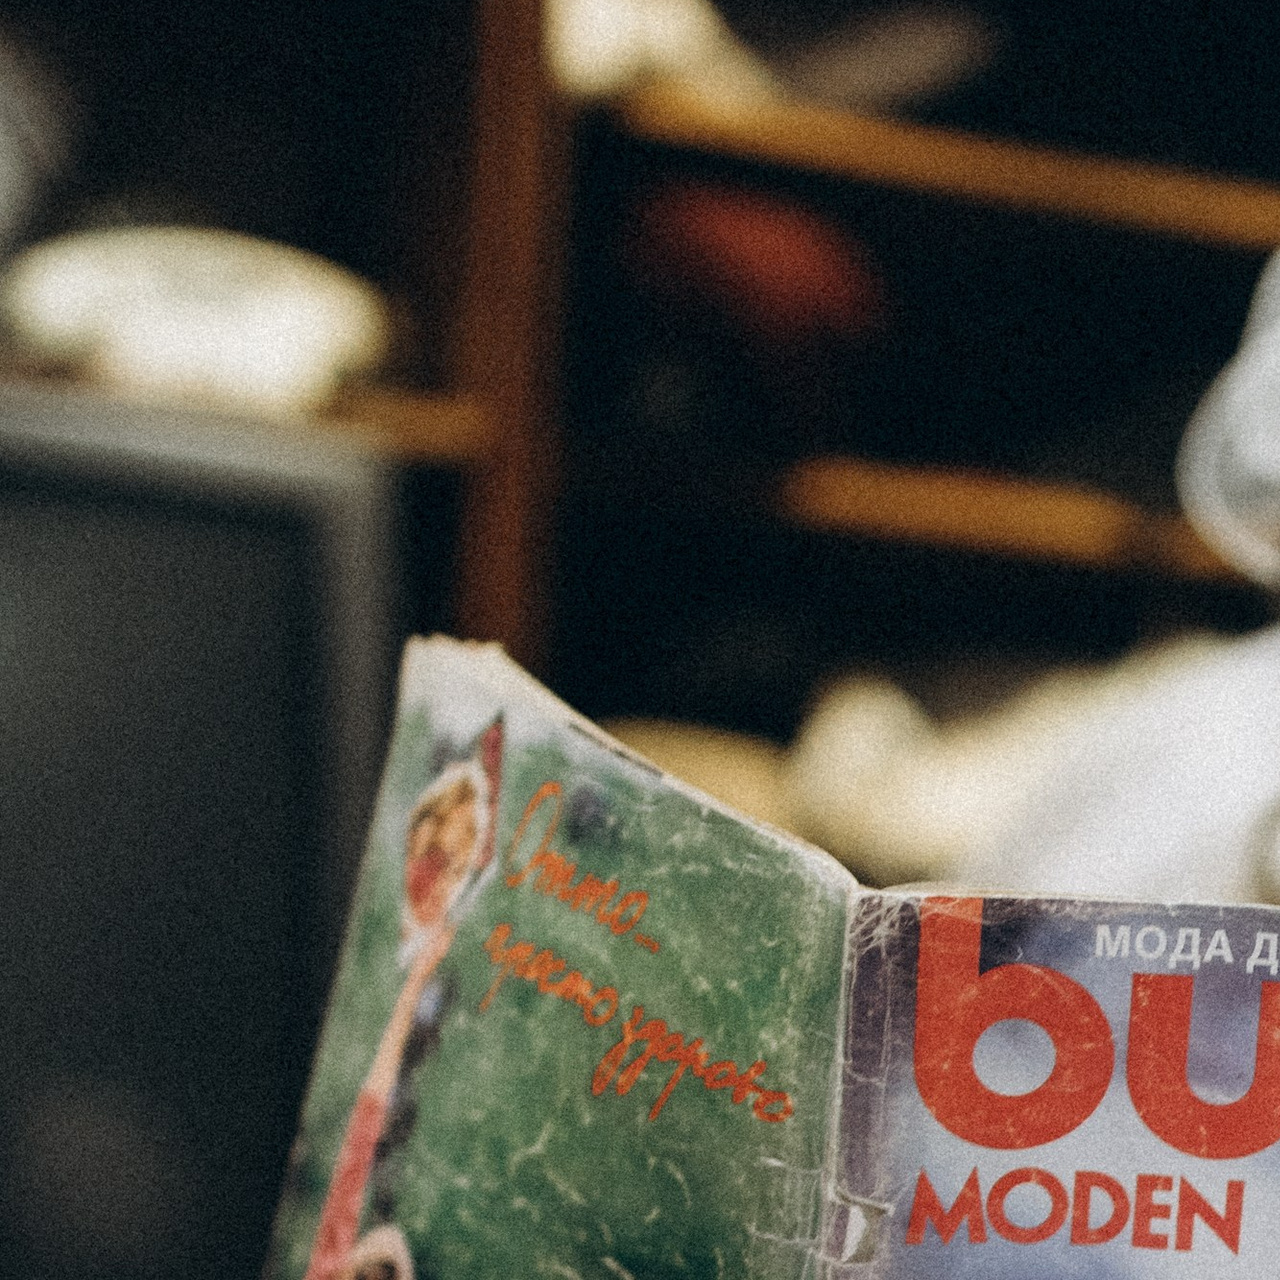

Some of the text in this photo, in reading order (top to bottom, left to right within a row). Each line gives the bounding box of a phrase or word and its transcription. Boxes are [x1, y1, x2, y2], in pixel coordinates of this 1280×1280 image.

[1096, 924, 1233, 971] МОДА
[592, 1006, 793, 1122] здорово
[906, 1167, 1244, 1255] MODEN
